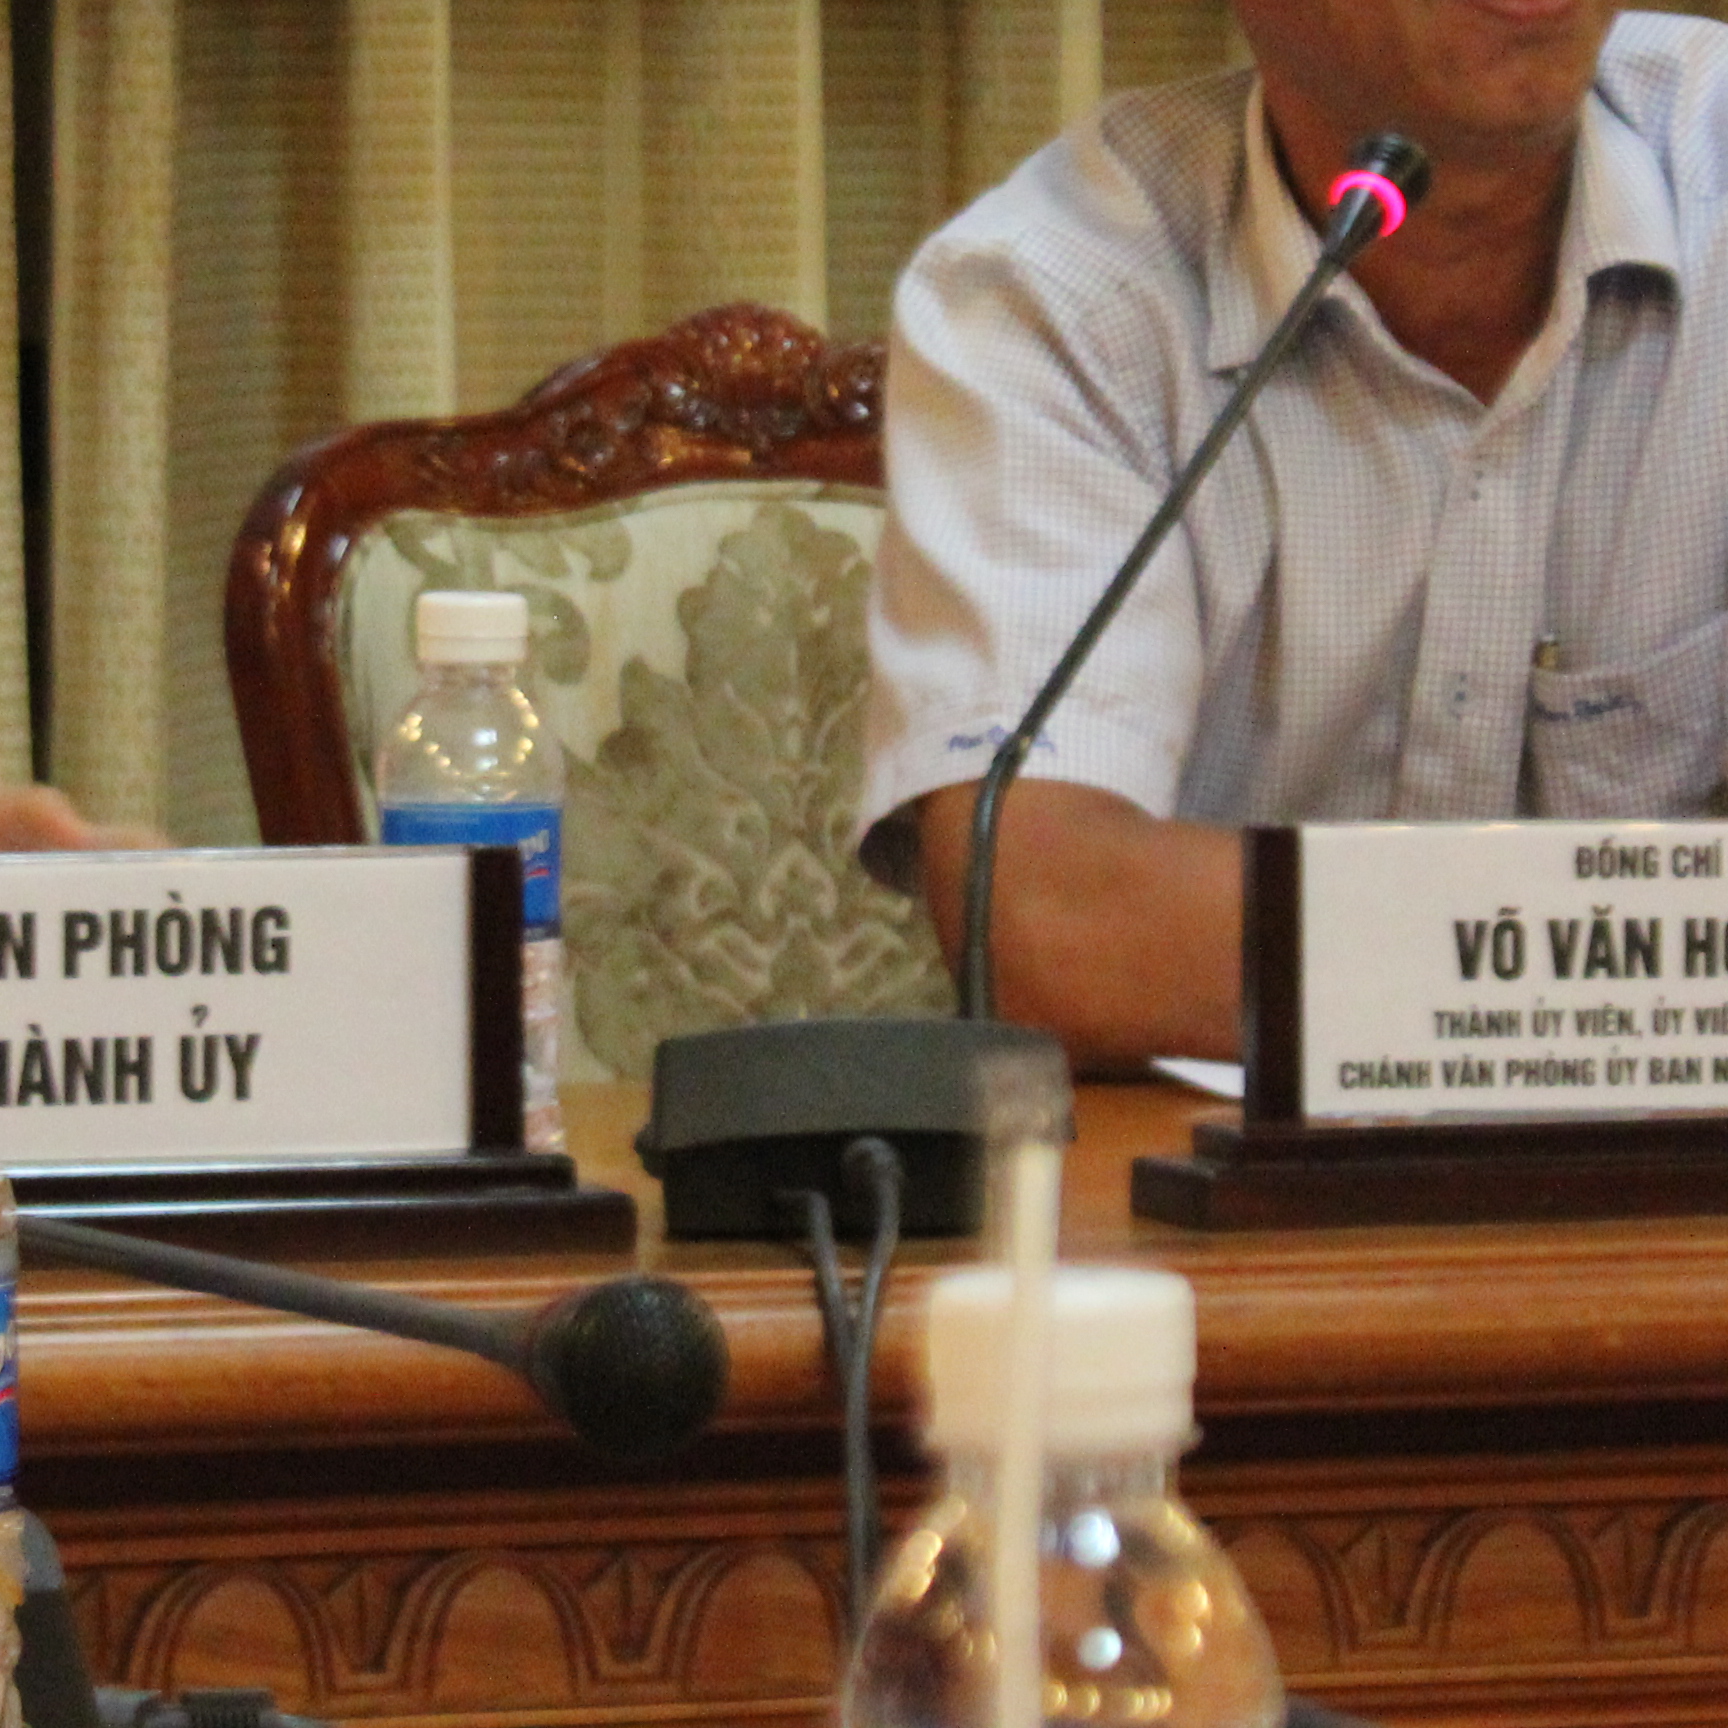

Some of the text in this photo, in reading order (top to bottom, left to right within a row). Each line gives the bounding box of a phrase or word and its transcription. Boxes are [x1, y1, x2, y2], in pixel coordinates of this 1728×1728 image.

[1672, 837, 1722, 878] CHÍ
[63, 890, 291, 978] PHÒNG
[1453, 906, 1526, 980] VÕ
[1546, 904, 1662, 980] VĂN
[1434, 1004, 1521, 1039] THÀNH
[1531, 996, 1564, 1038] ỦY
[1651, 995, 1686, 1036] ỦY
[179, 1004, 261, 1102] ỦY
[1338, 1055, 1432, 1090] CHÁNH
[1441, 1053, 1495, 1088] VĂN
[1504, 1049, 1596, 1087] PHÒNG
[1605, 1044, 1639, 1086] ỦY
[1648, 1056, 1703, 1085] BAN
